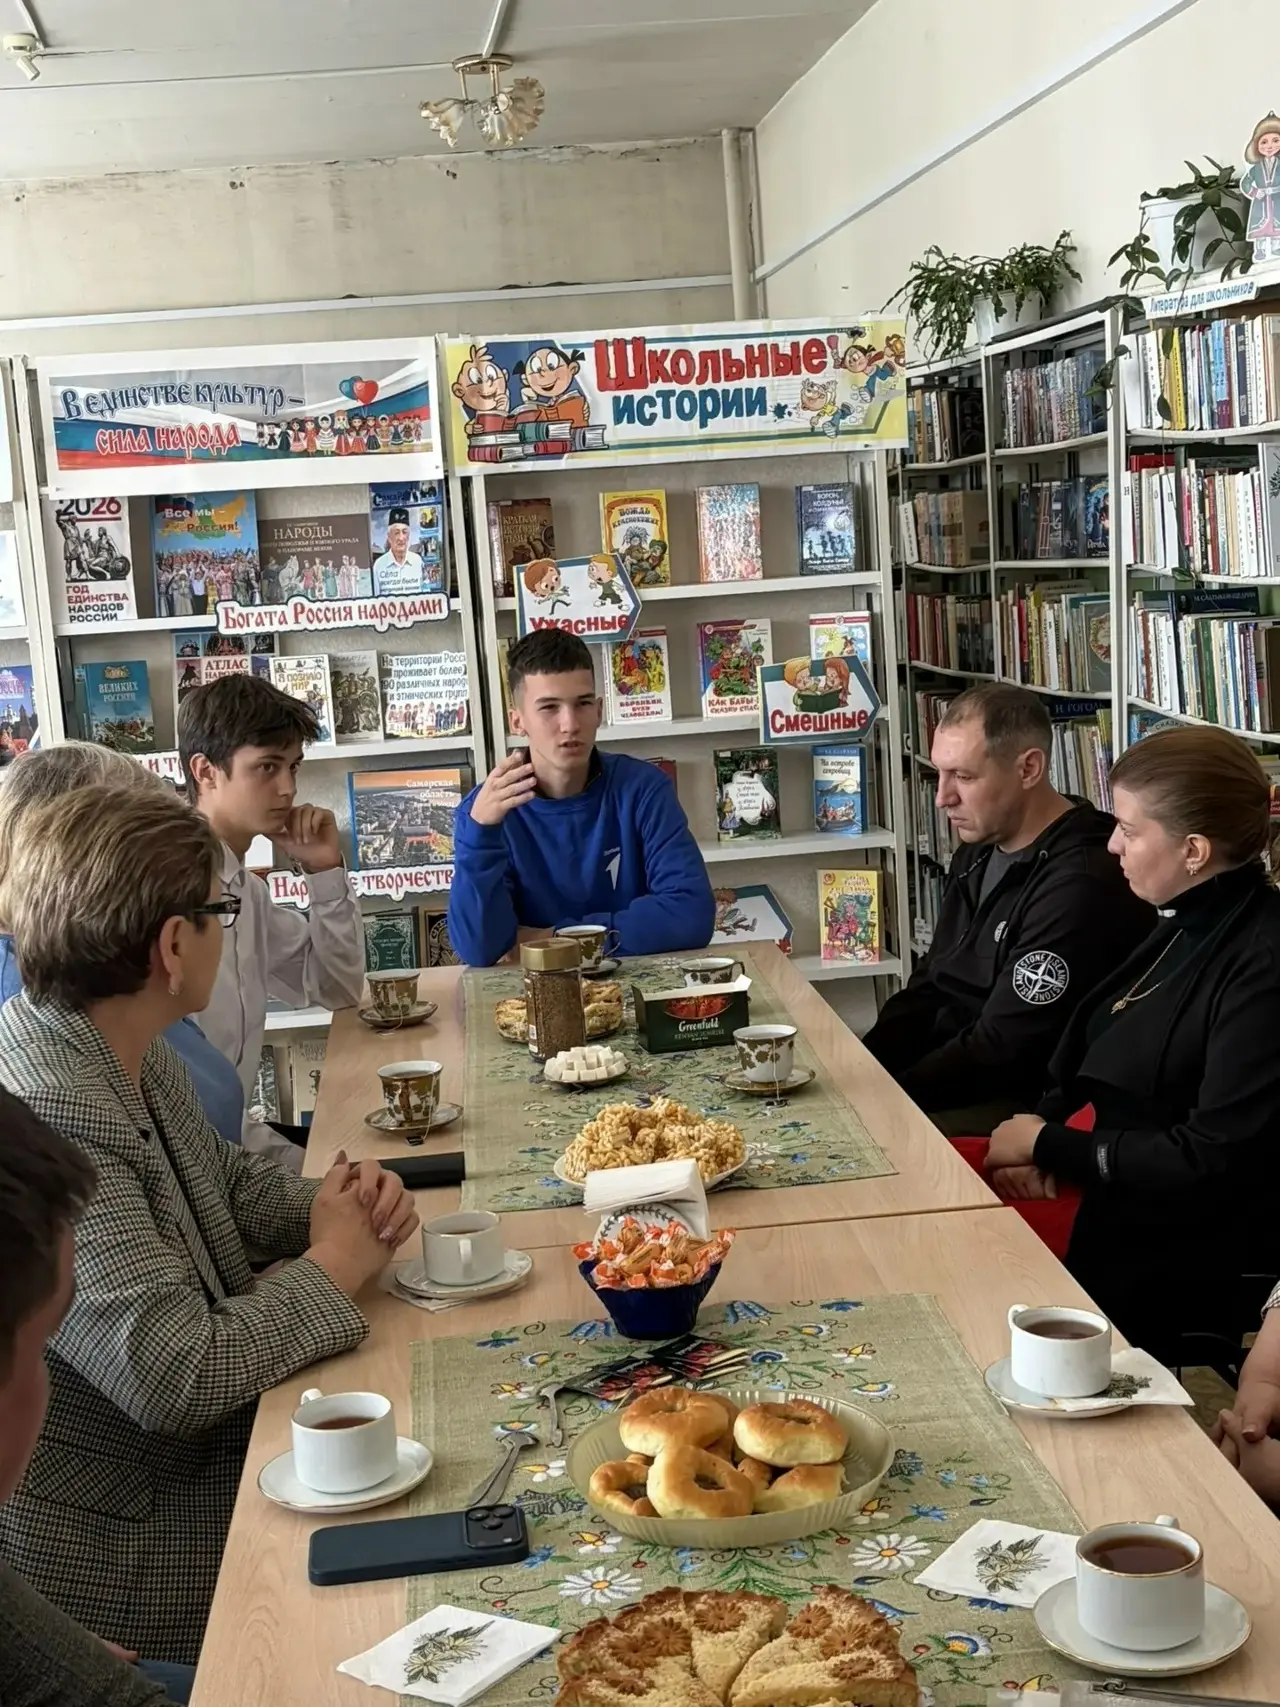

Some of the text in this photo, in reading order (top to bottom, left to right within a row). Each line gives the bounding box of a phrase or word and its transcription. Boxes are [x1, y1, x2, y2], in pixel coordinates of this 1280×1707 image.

[1190, 290, 1205, 309] для
[1206, 281, 1255, 304] школьников
[594, 335, 829, 391] Школьные
[62, 388, 83, 420] В
[612, 384, 768, 429] истории
[165, 508, 190, 518] Все
[195, 507, 215, 517] мы
[187, 522, 239, 533] Россия!
[274, 526, 333, 539] НАРОДЫ
[66, 584, 90, 595] ГОД
[68, 593, 129, 604] ЕДИНСТВА
[68, 603, 124, 614] НАРОДОВ
[223, 598, 443, 630] Богата Россия народами
[70, 613, 118, 623] РОССИИ
[530, 614, 630, 634] Ужасные
[205, 659, 248, 670] АТЛАС
[395, 655, 443, 667] территории
[708, 699, 727, 707] КАК
[771, 709, 868, 733] Смешные
[362, 869, 454, 895] творчеств
[1020, 953, 1067, 986] STONE ISLAND
[678, 1017, 719, 1032] Greenfield
